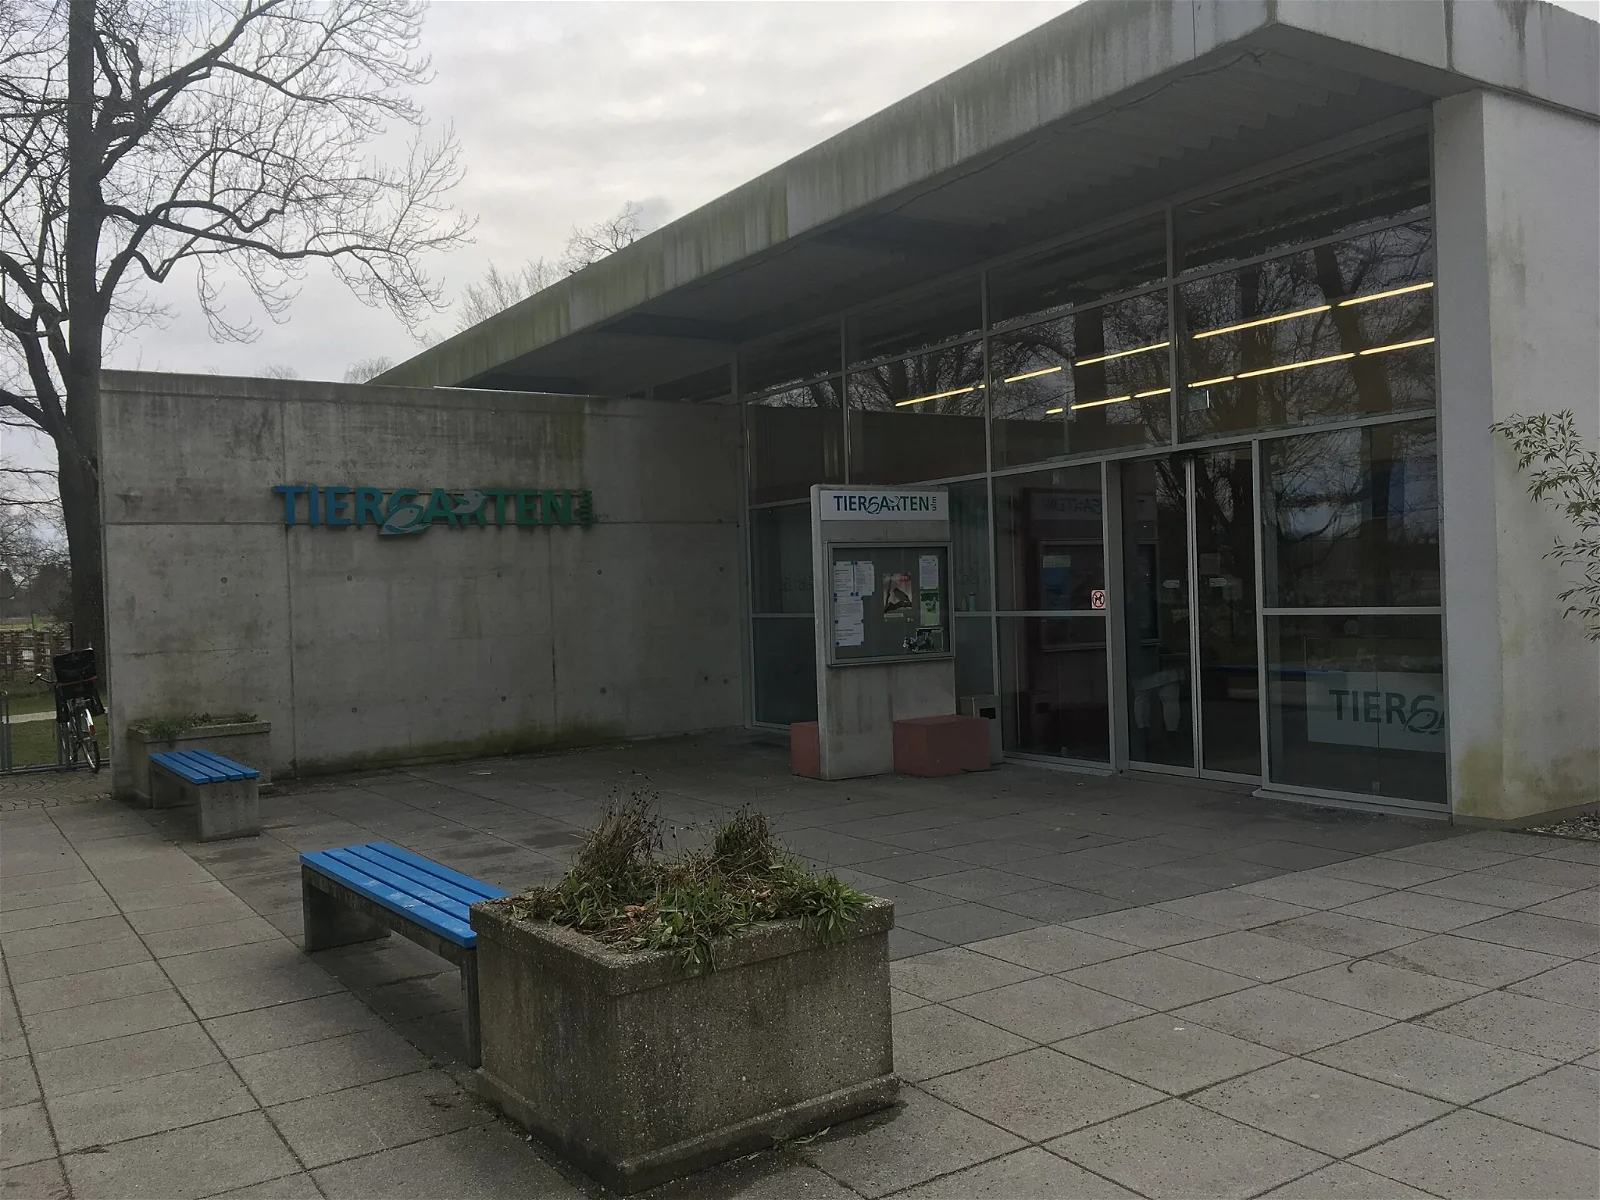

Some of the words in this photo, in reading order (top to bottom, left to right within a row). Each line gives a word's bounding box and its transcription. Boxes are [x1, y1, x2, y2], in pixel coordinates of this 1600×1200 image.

[273, 485, 571, 534] TIERGARTEN
[833, 495, 929, 515] TIERGARTEN
[1329, 689, 1445, 735] TIERG
